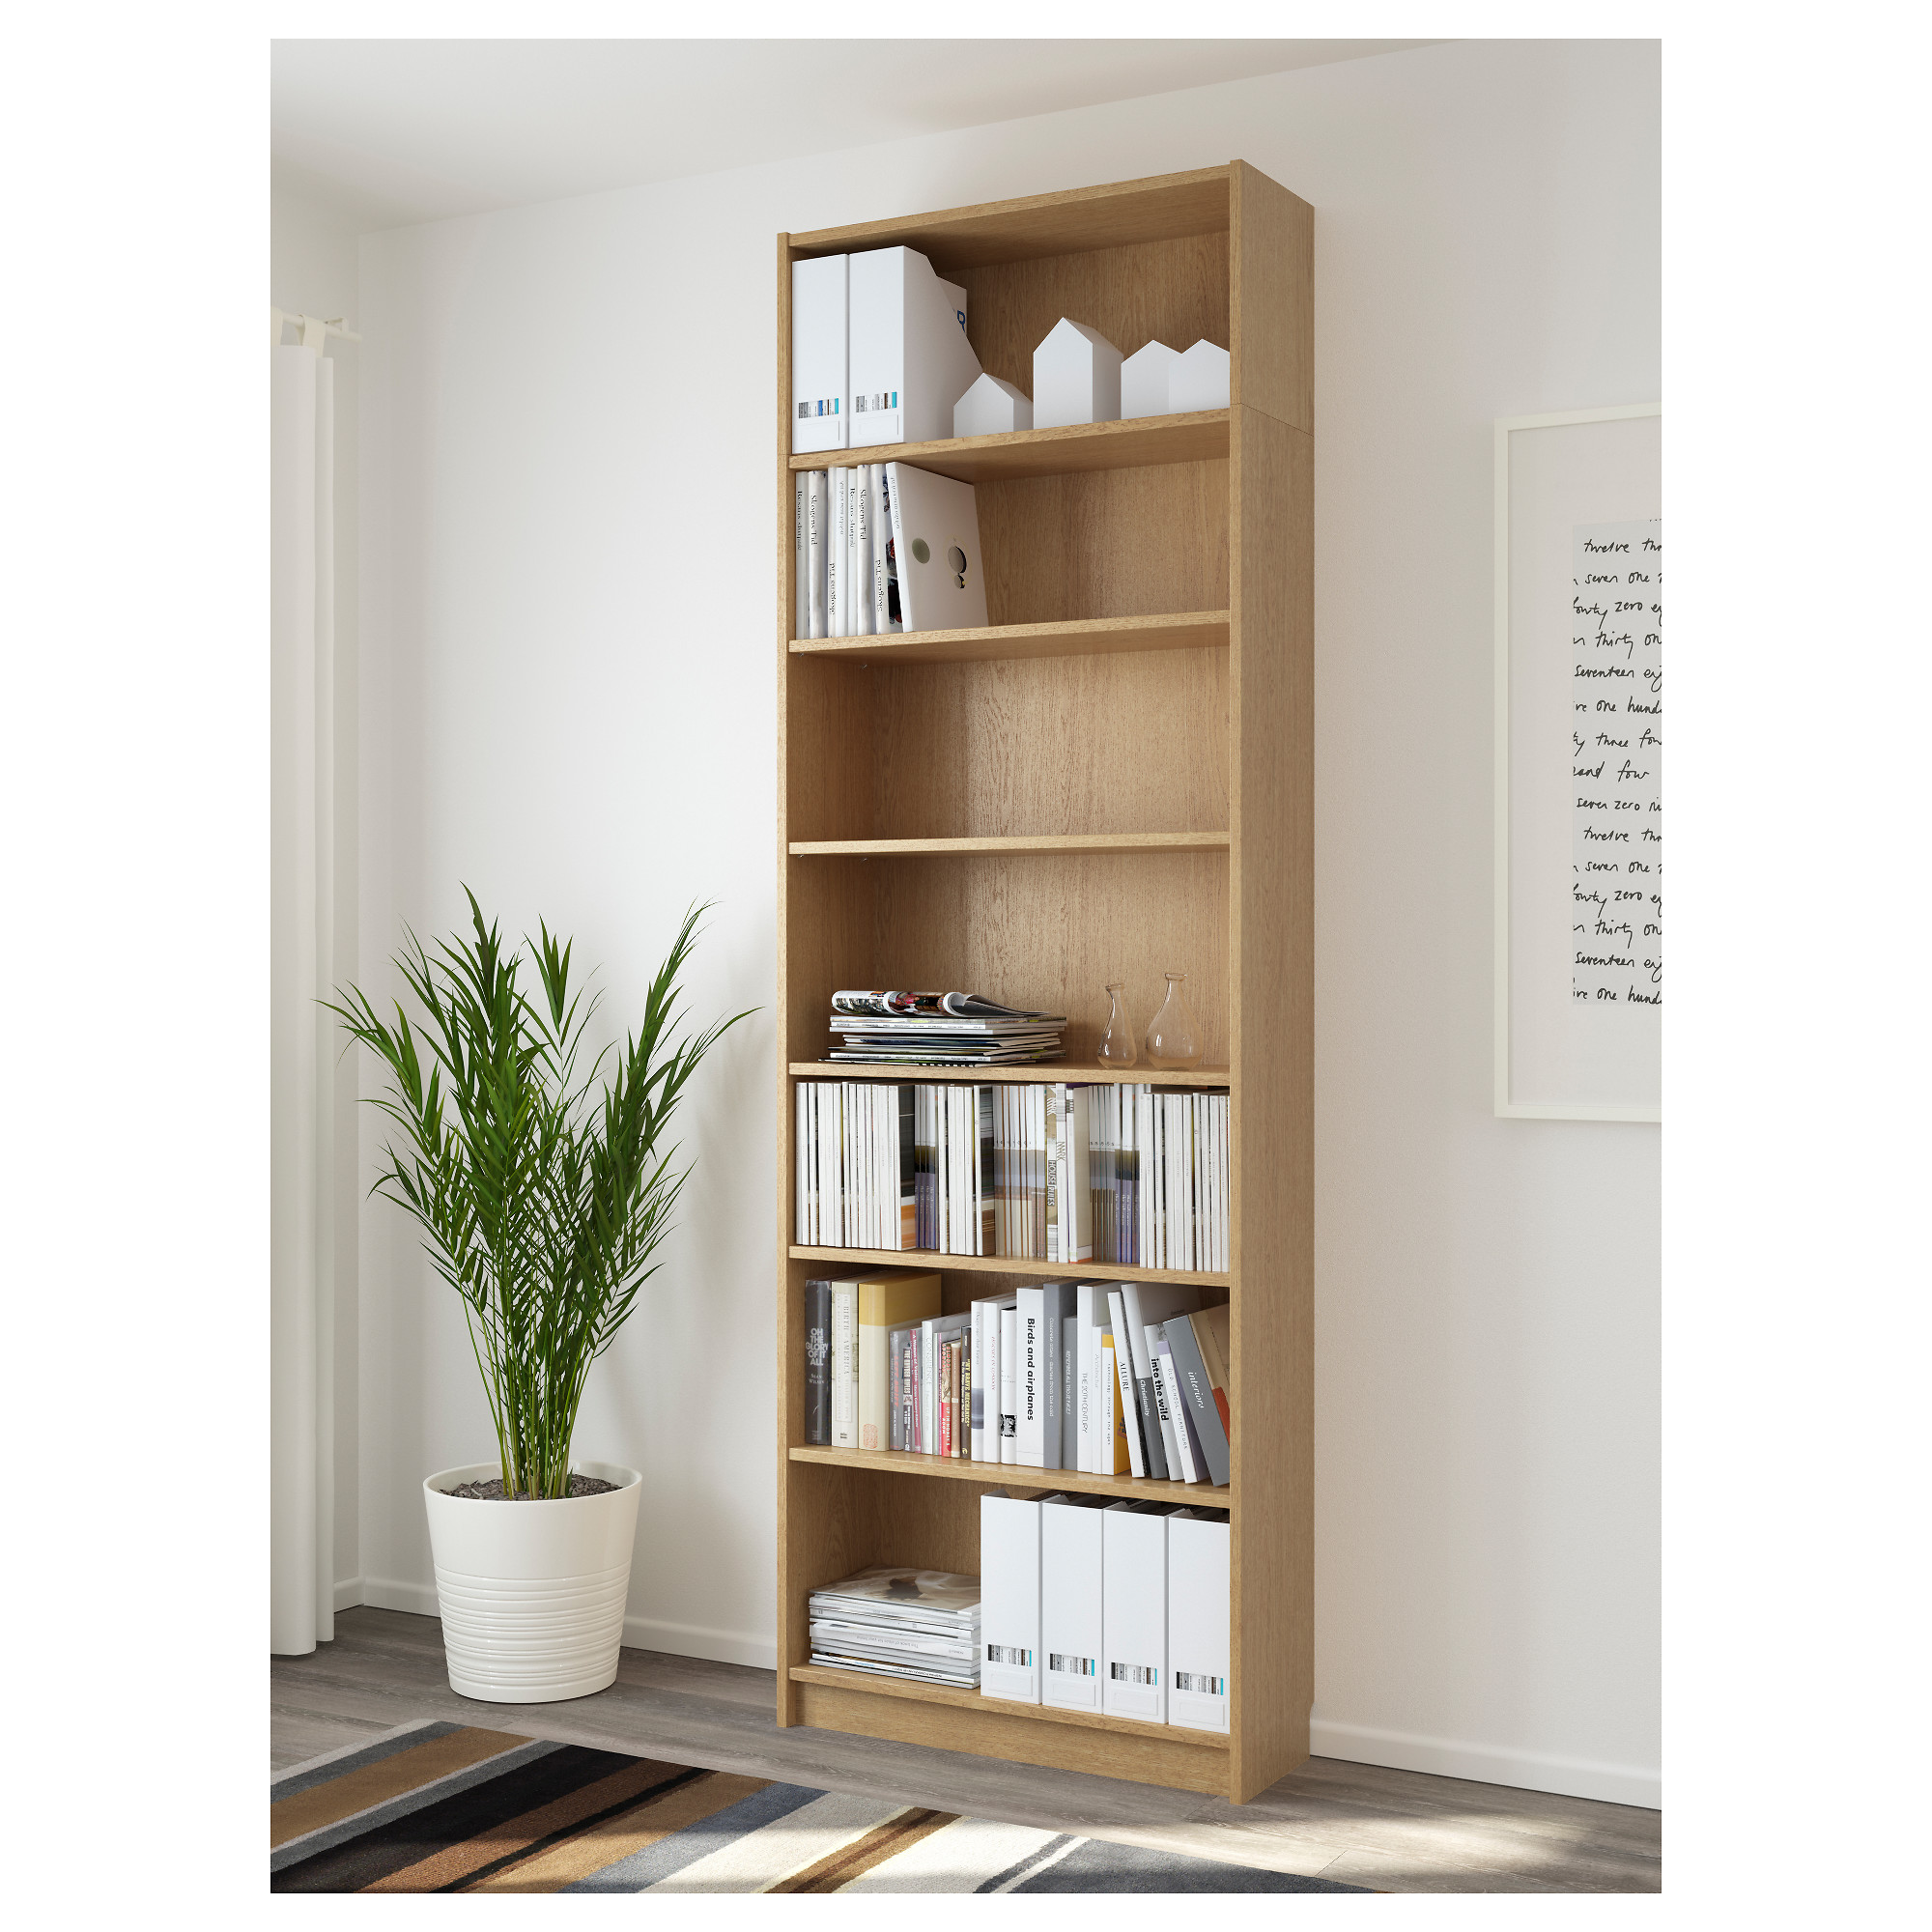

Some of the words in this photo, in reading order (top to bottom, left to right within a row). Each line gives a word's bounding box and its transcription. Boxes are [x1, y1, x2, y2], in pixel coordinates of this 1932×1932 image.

[810, 495, 818, 529] Skogens
[859, 489, 867, 524] Skogens
[810, 531, 818, 546] Tid
[859, 526, 867, 540] Tid
[1584, 539, 1630, 553] twelve
[1585, 574, 1618, 584] seven
[1629, 571, 1650, 584] one
[1615, 602, 1642, 611] zero
[1595, 631, 1633, 659] thirty
[1575, 665, 1634, 678] seventeen
[1597, 700, 1616, 713] one
[1596, 732, 1628, 748] three
[1618, 759, 1649, 781] four
[1577, 798, 1607, 810] seven
[1614, 800, 1640, 810] zero
[1584, 826, 1629, 842] twelve
[1585, 862, 1618, 872] seven
[1629, 862, 1650, 873] one
[1614, 891, 1642, 901] zero
[1595, 920, 1633, 949] thirty
[1576, 952, 1634, 967] seventeen
[1598, 988, 1617, 1001] one
[1048, 1160, 1057, 1185] HOUSE
[1046, 1185, 1056, 1207] RULES
[810, 1327, 824, 1336] OH
[1027, 1318, 1036, 1345] Birds
[1027, 1347, 1036, 1368] and
[1119, 1362, 1130, 1392] ALLURE
[1151, 1358, 1159, 1378] into
[1026, 1371, 1036, 1421] airplanes
[1154, 1379, 1164, 1397] the
[1187, 1372, 1206, 1408] interiors
[1139, 1379, 1151, 1417] Christianity
[1157, 1399, 1170, 1421] wild
